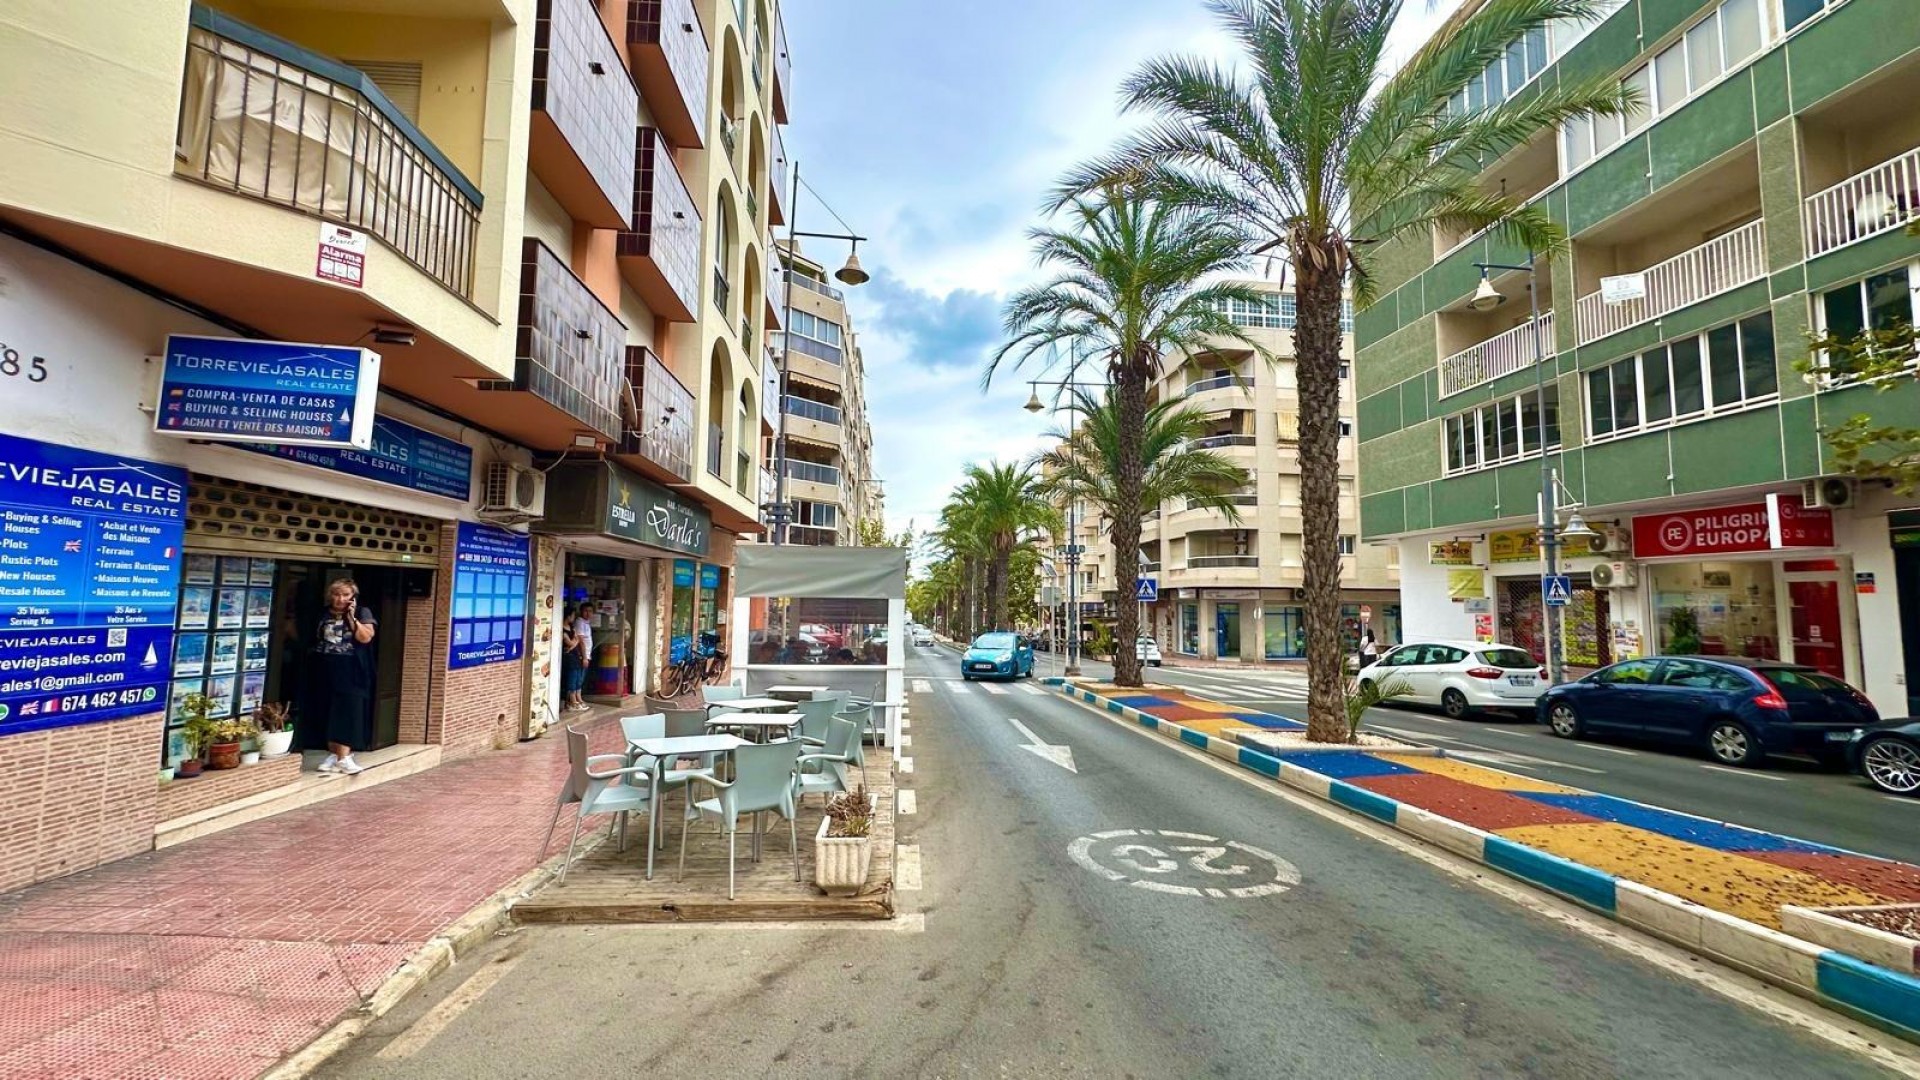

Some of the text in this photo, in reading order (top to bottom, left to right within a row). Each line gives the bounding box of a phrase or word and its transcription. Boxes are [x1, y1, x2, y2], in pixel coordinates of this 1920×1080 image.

[321, 246, 362, 264] Alarma
[173, 353, 356, 380] TORREVIEJASALES
[276, 379, 353, 391] REAL ESTATE
[186, 388, 336, 409] COMPRA-VENTA DE CASAS
[185, 402, 334, 423] BUYING & SELLING HOUSES
[182, 416, 216, 428] ACHAT
[217, 419, 230, 429] ET
[264, 422, 284, 433] DES
[286, 424, 331, 437] MAISONS
[340, 449, 367, 465] REAL
[371, 458, 407, 476] ESTATE
[71, 496, 179, 517] REAL ESTATE
[5, 510, 83, 529] Buying & Selling
[5, 522, 41, 535] Houses
[103, 520, 161, 535] Achat et Vente
[2, 538, 29, 550] Plots
[102, 531, 151, 544] des Maisons
[101, 545, 134, 556] Terrains
[1, 554, 59, 566] Rustic Plots
[100, 559, 170, 572] Terrains Rustiques
[0, 570, 57, 581] New Houses
[98, 573, 159, 584] Maisons Neuves
[0, 586, 66, 596] Resale Houses
[96, 587, 171, 598] Maisons de Revente
[17, 605, 50, 615] 35 Years
[114, 605, 124, 614] 35
[10, 616, 54, 627] Serving You
[125, 615, 148, 623] Service
[0, 635, 97, 648] VIEJASALES
[0, 652, 126, 671] eviejasales.com
[0, 672, 125, 692] ales1@gmail.com
[61, 688, 143, 712] 674 462 457
